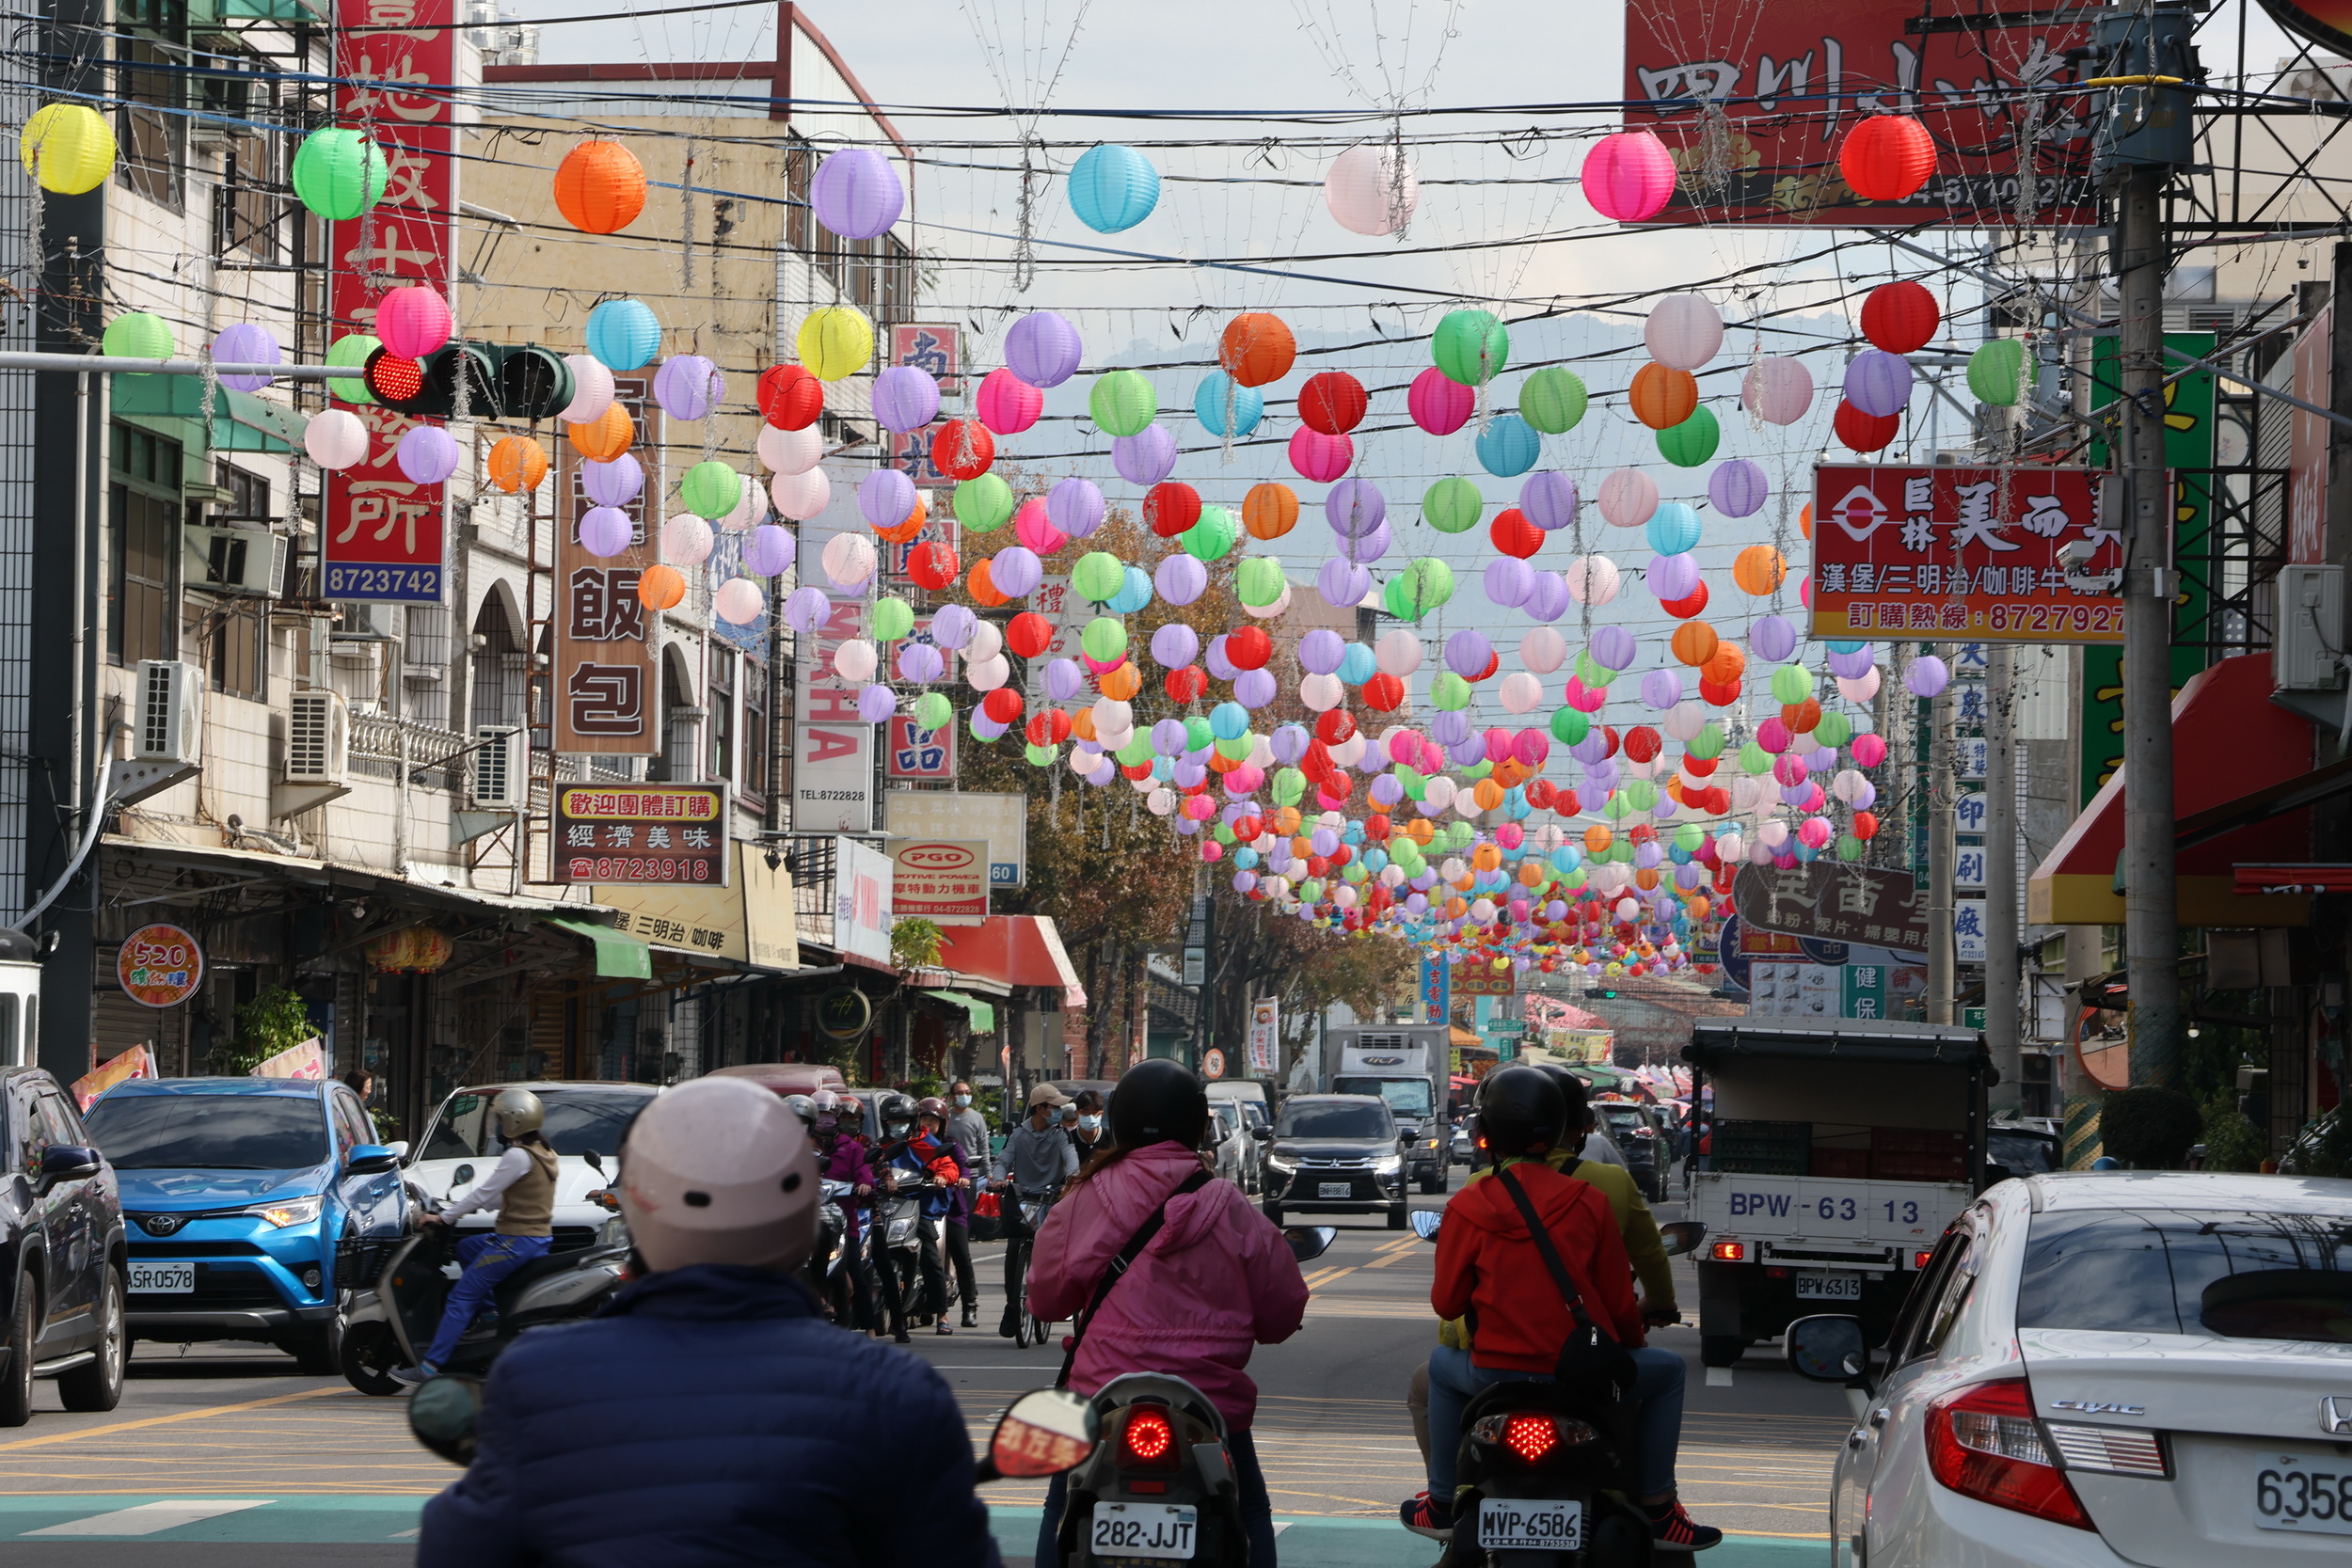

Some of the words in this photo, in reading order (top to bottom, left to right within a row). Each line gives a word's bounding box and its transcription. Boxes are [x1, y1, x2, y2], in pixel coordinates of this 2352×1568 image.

[1899, 477, 1938, 553] 巨林
[329, 567, 437, 594] 8723742
[568, 792, 712, 818] 歡迎團體訂購
[799, 788, 866, 802] TEL:8722828
[566, 823, 712, 850] 經濟美味
[596, 857, 709, 881] 8723918
[911, 852, 962, 863] PGO
[991, 865, 1010, 880] 60
[134, 942, 187, 968] 520
[1854, 966, 1878, 1021] 健保
[1797, 1276, 1860, 1296] BPW-6313
[2050, 1400, 2146, 1416] CIVIC
[1095, 1519, 1194, 1549] 282-JJT
[1483, 1512, 1578, 1538] MVP-6586
